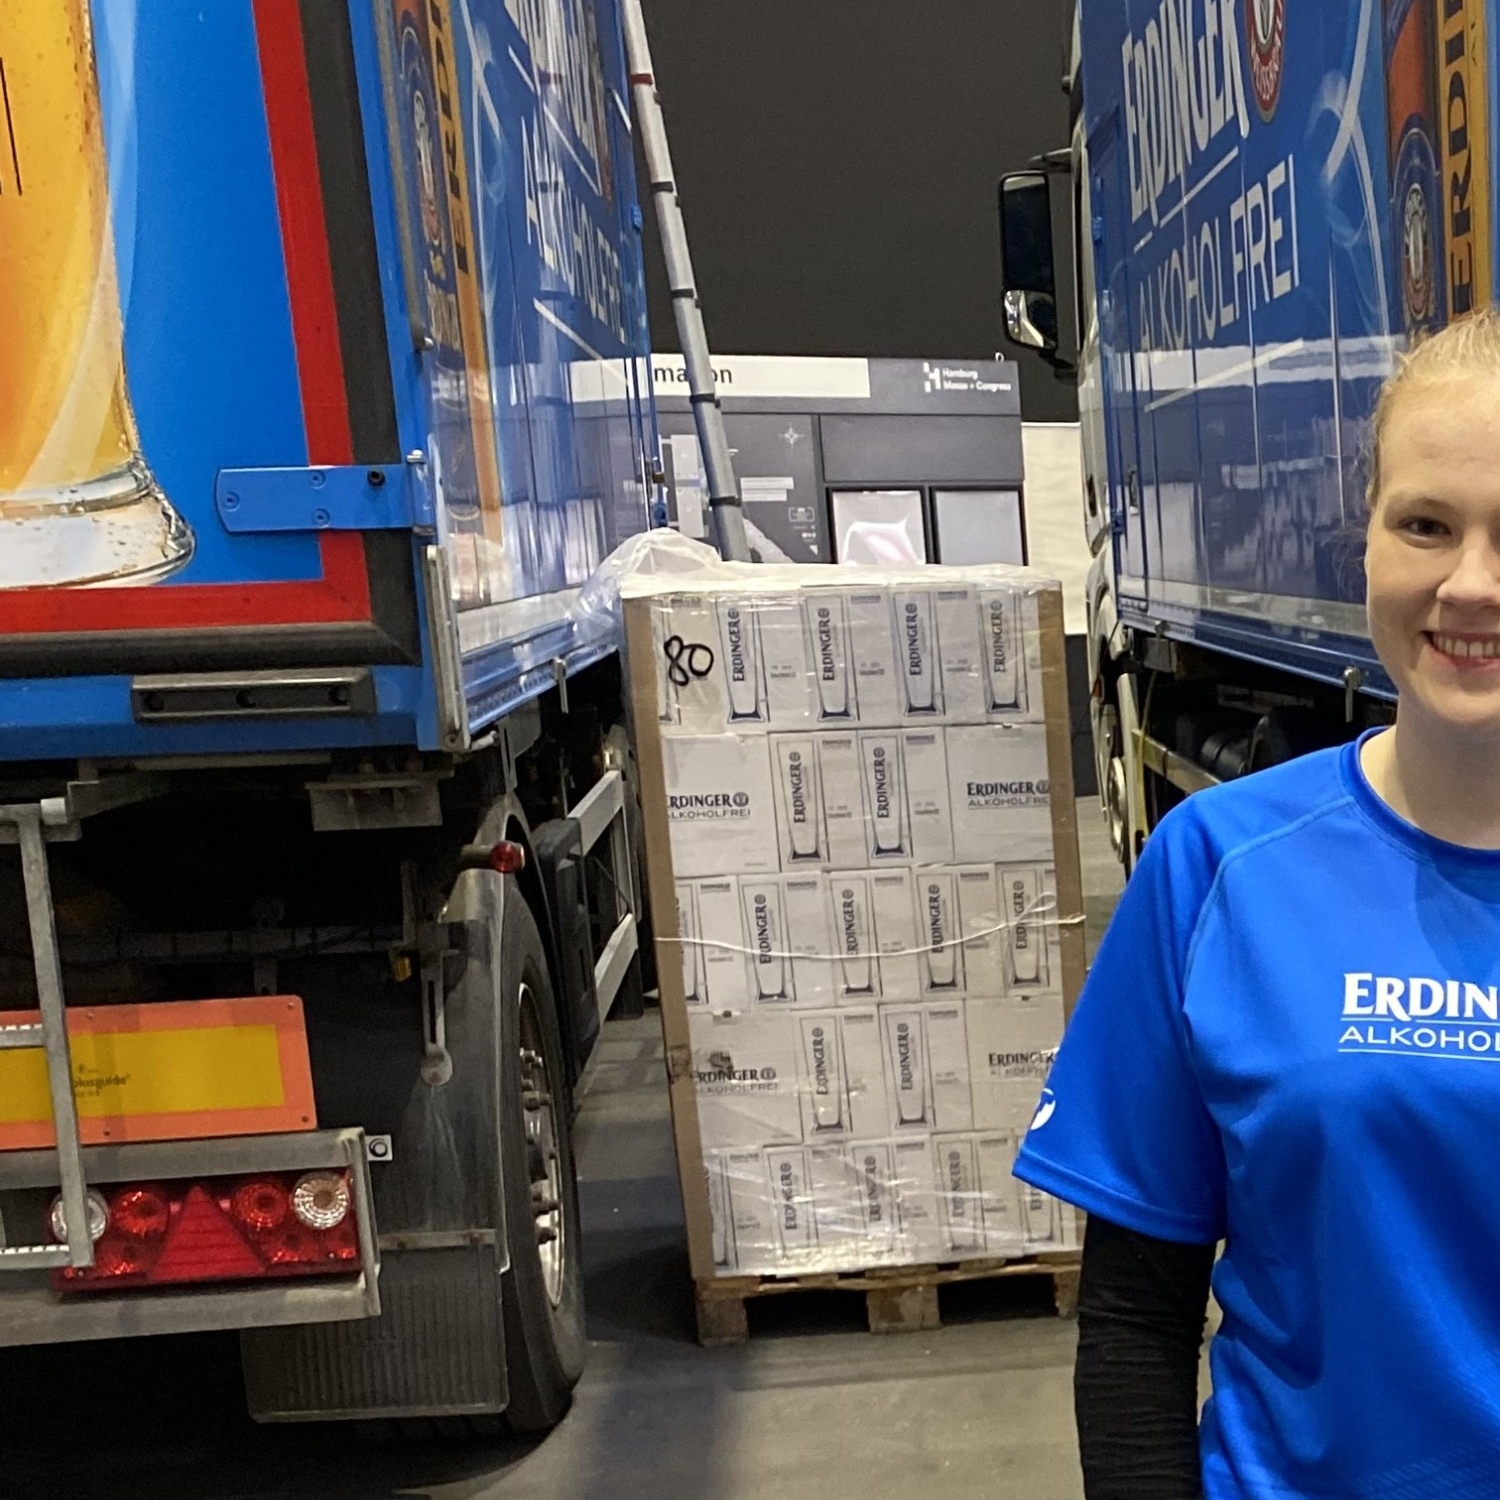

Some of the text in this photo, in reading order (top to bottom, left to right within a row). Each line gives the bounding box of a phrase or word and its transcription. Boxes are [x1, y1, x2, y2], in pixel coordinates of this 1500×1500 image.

[1137, 153, 1299, 353] ALKOHOLFREI
[664, 635, 714, 686] 80
[728, 618, 746, 682] ERDINGER
[818, 617, 835, 681] ERDINGER
[906, 613, 922, 676] ERDINGER
[991, 611, 1007, 673] ERDINGER
[668, 794, 733, 809] RDINGER
[790, 763, 806, 823] ERDINGER
[874, 757, 890, 819] ERDINGER
[967, 781, 1037, 797] ERDINGER
[968, 796, 1049, 807] ALKOHOLFRE
[1014, 891, 1028, 949] ERDGER
[898, 1031, 913, 1091] ERDINGER
